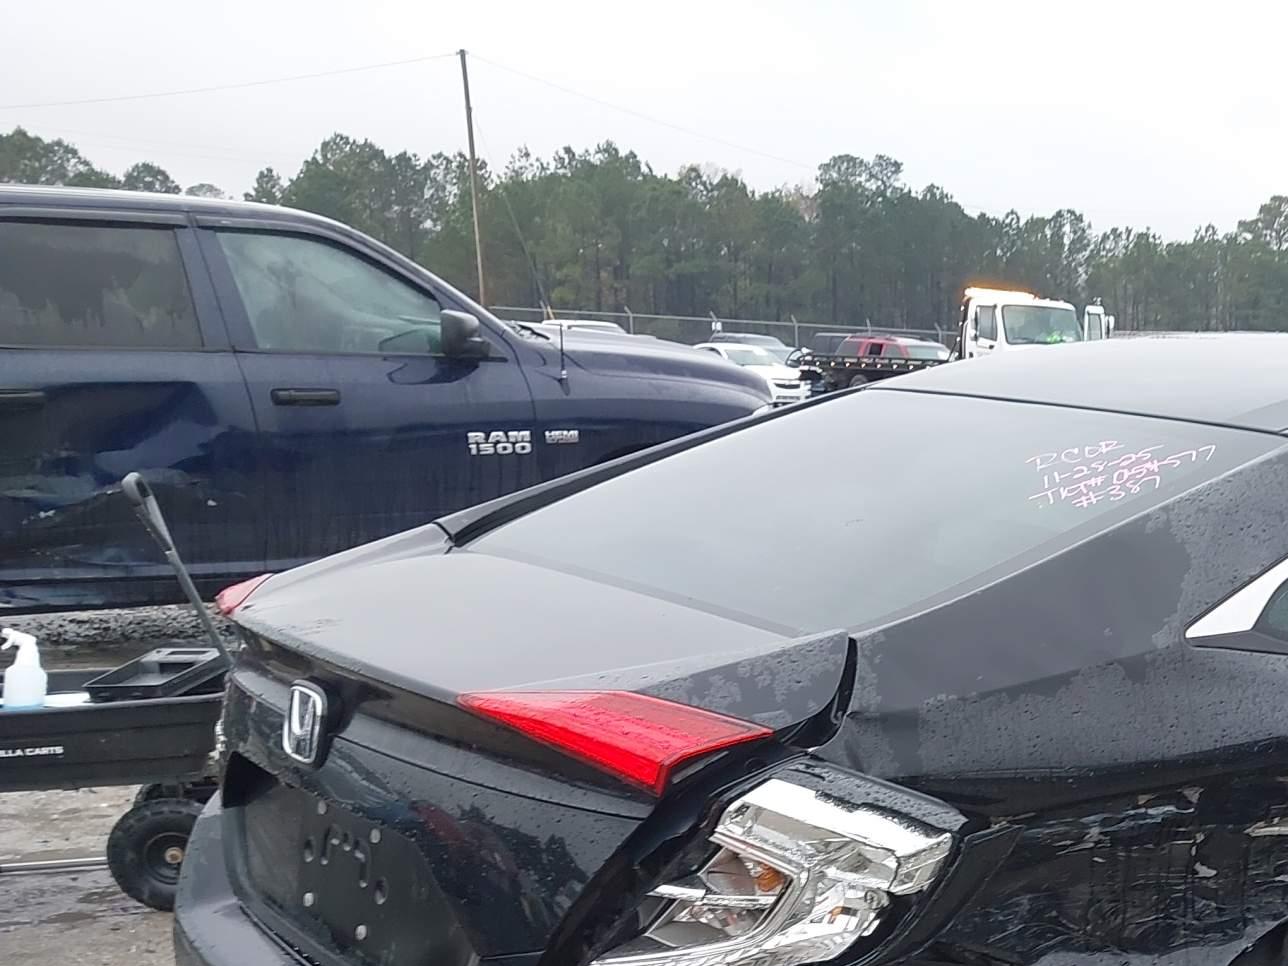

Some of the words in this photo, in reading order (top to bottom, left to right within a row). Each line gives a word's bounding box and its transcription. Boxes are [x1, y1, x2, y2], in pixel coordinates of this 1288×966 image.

[467, 430, 531, 443] RAM
[468, 442, 532, 455] 1500
[24, 746, 64, 756] CARTS
